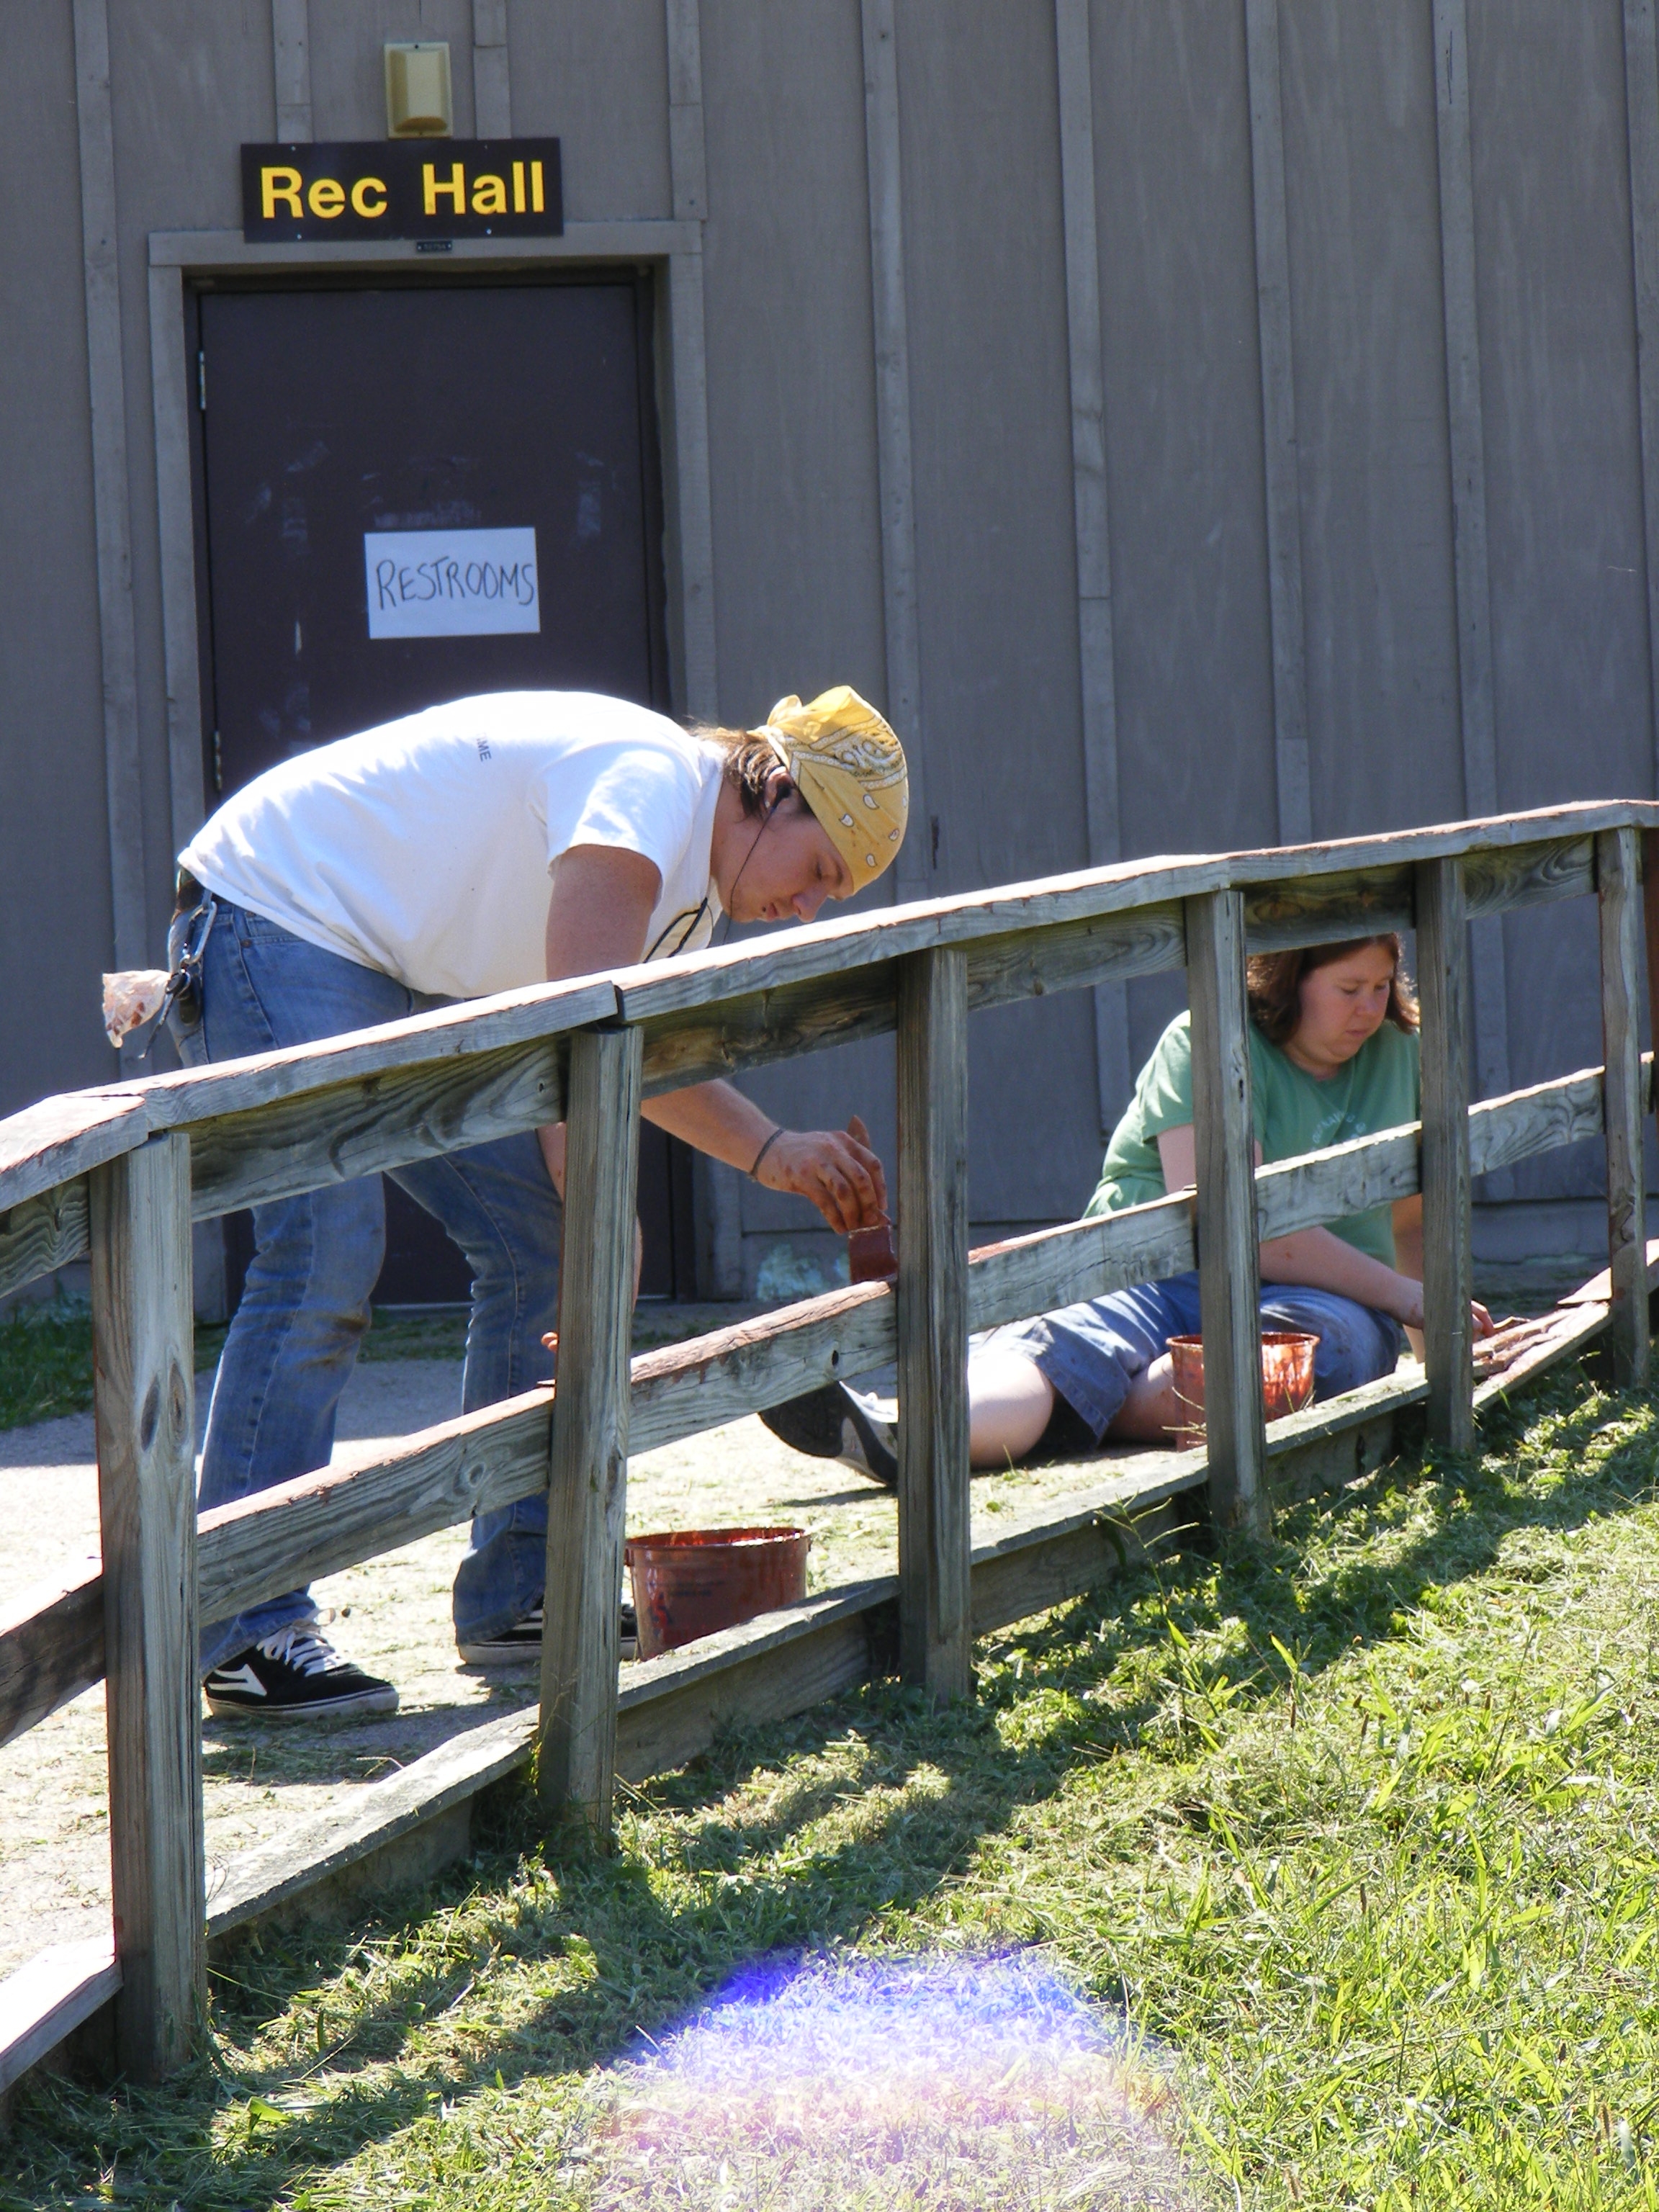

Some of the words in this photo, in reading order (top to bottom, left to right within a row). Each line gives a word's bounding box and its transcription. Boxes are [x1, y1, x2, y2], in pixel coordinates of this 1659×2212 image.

[261, 166, 388, 219] Rec
[423, 161, 545, 215] Hall
[376, 555, 534, 610] RESTROOMS
